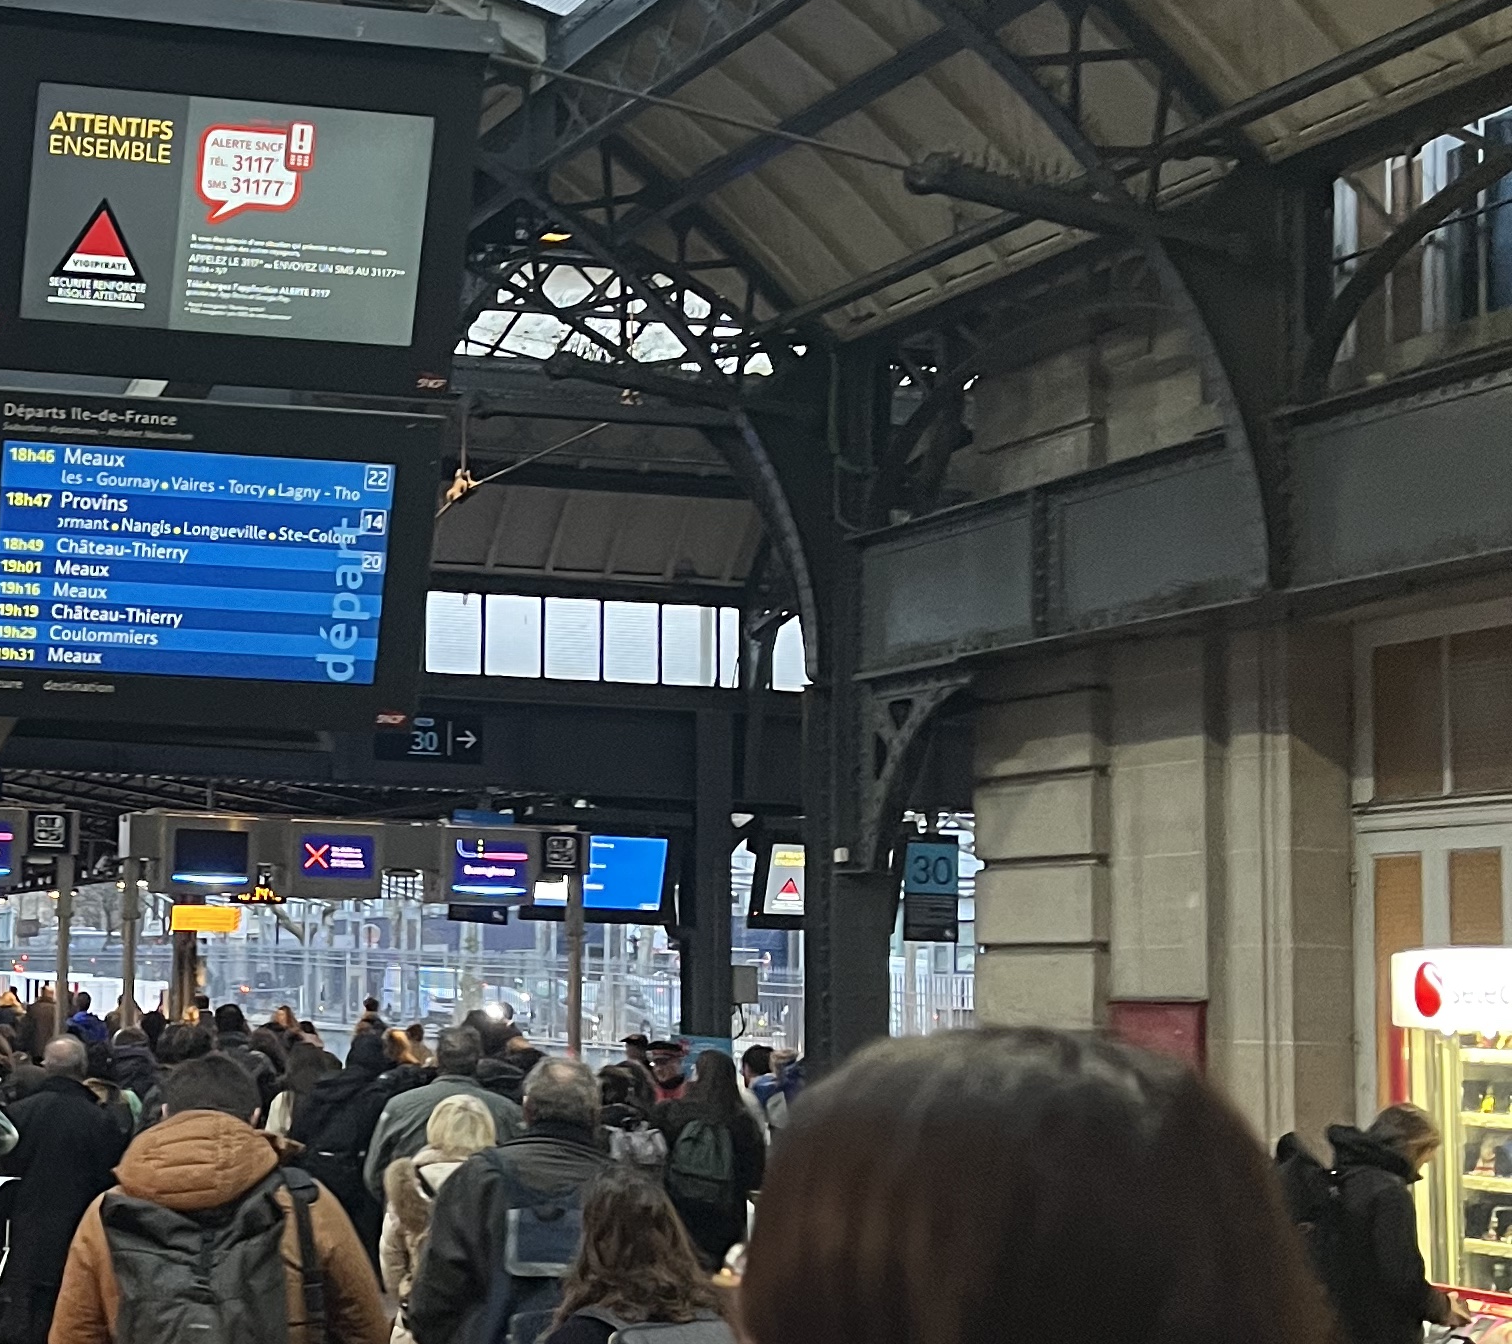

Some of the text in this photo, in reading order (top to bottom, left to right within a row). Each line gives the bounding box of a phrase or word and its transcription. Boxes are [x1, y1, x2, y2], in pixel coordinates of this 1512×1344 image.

[49, 110, 174, 141] ATTENTIFS
[49, 134, 172, 164] ENSEMBLE
[211, 137, 283, 152] ALERTE SNCF
[207, 179, 227, 190] SMS
[73, 258, 127, 270] VIGIPIRATE
[334, 265, 354, 275] SMS
[356, 266, 369, 276] AU
[4, 403, 178, 426] Départs Ile-de-France
[9, 448, 387, 486] 18h46 Meaux 22
[61, 470, 360, 501] les Gournay Vaires Torcy Lagny Tho
[6, 492, 383, 529] 18h47 Provins 14
[122, 518, 171, 536] Nangis
[183, 522, 267, 541] Longueville
[3, 538, 381, 569] 18h49 Château-Thierry 20
[0, 560, 110, 577] 19h01 Meaux
[0, 582, 108, 599] 19h16 Meaux
[52, 604, 182, 628] Château-Thierry
[49, 625, 158, 645] Coulommiers
[47, 648, 102, 664] Meaux
[411, 731, 438, 750] 30
[912, 856, 952, 885] 30
